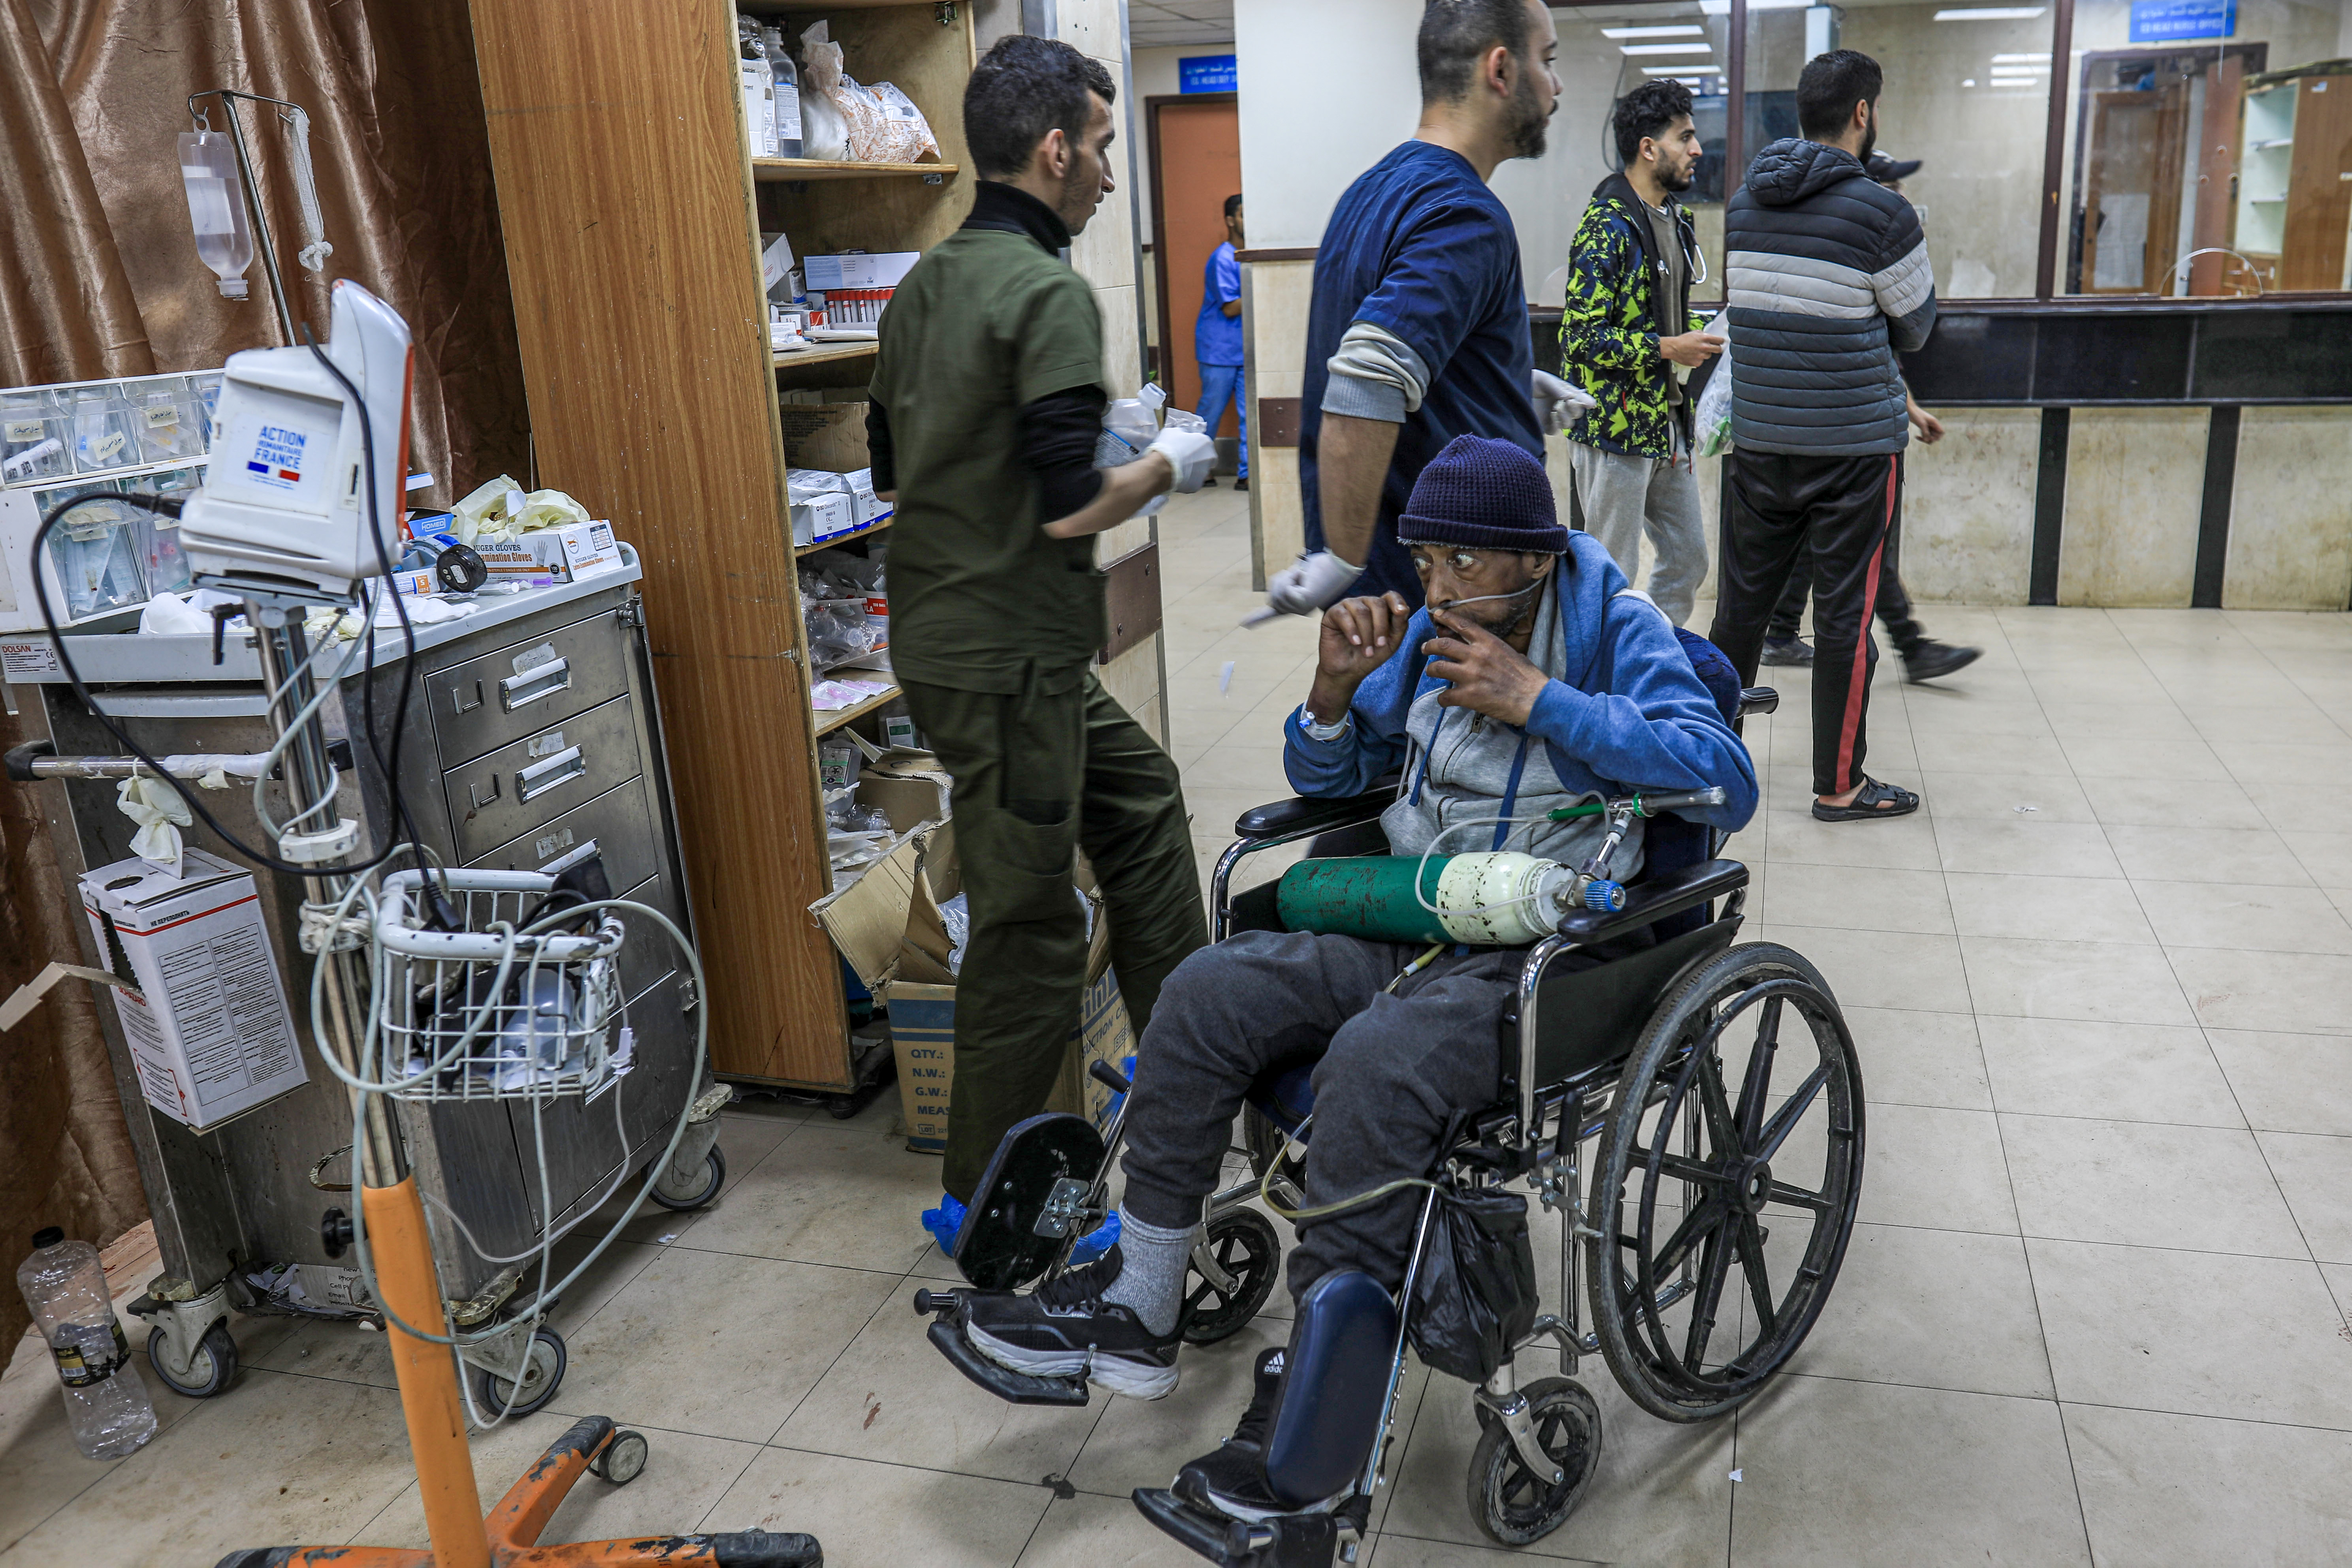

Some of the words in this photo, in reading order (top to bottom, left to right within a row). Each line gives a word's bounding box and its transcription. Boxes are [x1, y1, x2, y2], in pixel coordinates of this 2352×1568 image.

[259, 425, 307, 448] ACTION
[258, 440, 303, 457] HUMANITAIRE
[254, 447, 301, 469] FRANCE
[422, 520, 444, 530] HOMED
[480, 553, 511, 562] amination
[512, 552, 533, 562] Gloves
[1082, 1015, 1113, 1058] SUCTION
[911, 1049, 943, 1059] QTY.:
[912, 1068, 945, 1078] N.W.:
[915, 1087, 947, 1097] G.W.:
[1265, 1364, 1283, 1374] adida
